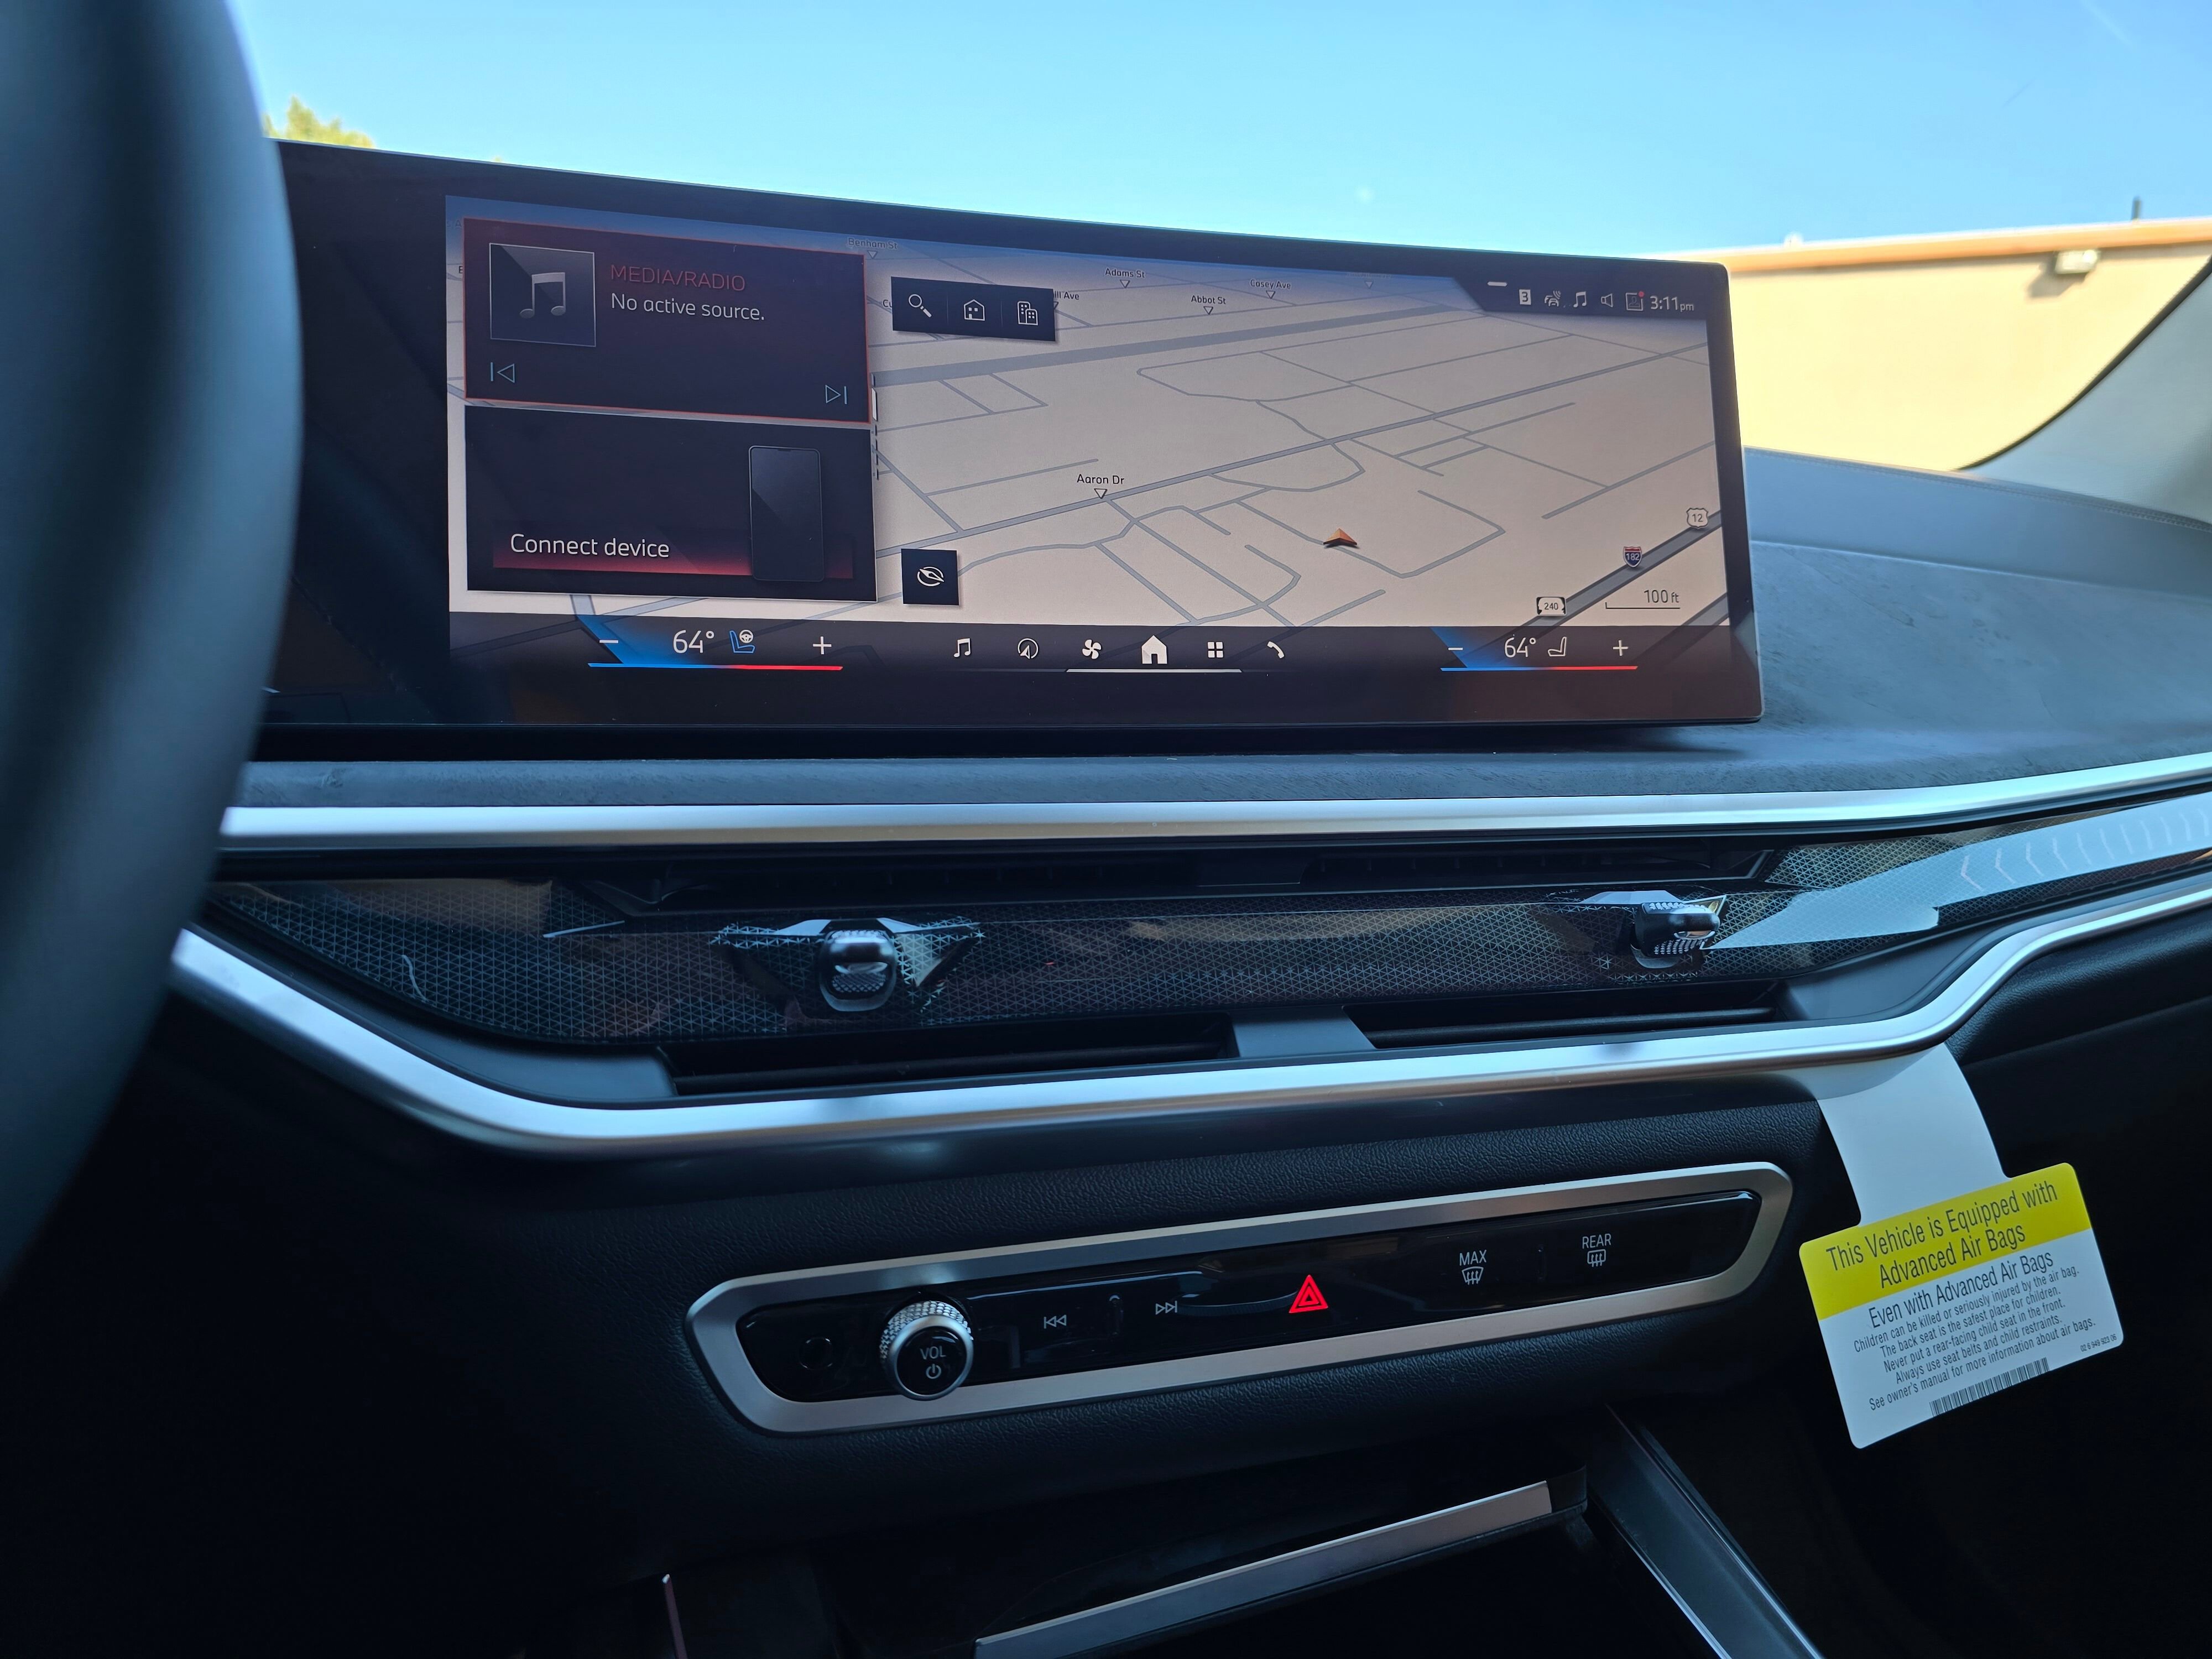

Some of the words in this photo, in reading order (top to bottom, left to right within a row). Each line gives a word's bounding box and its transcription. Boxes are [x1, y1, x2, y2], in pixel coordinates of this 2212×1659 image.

[848, 238, 885, 248] Benham
[611, 264, 745, 291] MEDIA/RADIO
[1105, 268, 1134, 278] Adams
[1136, 270, 1145, 278] St
[1250, 279, 1274, 289] Casey
[1276, 281, 1291, 289] Ave
[1063, 291, 1079, 300] Ave
[1191, 295, 1215, 304] Abbot
[1217, 296, 1226, 305] St
[612, 293, 637, 311] No
[643, 295, 696, 316] active
[701, 302, 765, 321] source.
[1077, 473, 1109, 484] Aaron
[1112, 475, 1125, 484] Dr
[1692, 513, 1703, 523] 12
[510, 533, 598, 556] Connect
[604, 538, 670, 558] device
[1625, 553, 1640, 562] 182
[1644, 589, 1669, 603] 100
[1671, 592, 1679, 603] ft
[1544, 602, 1559, 611] 240
[673, 629, 714, 654] 64°
[1505, 637, 1536, 658] 64°
[1825, 1241, 1864, 1271] This
[1864, 1222, 1926, 1258] Vehicle
[1927, 1216, 1944, 1239] is
[1945, 1190, 2020, 1233] Equipped
[2021, 1180, 2058, 1208] with
[1582, 1233, 1611, 1249] REAR
[1459, 1249, 1487, 1266] MAX
[1880, 1241, 1957, 1289] Advanced
[1960, 1235, 1982, 1261] Air
[1984, 1225, 2026, 1252] Bags
[1868, 1303, 1903, 1329] Even
[1903, 1289, 1934, 1316] with
[1936, 1265, 1999, 1306] Advanced
[2000, 1260, 2018, 1283] Air
[2019, 1252, 2054, 1275] Bags
[1854, 1332, 1889, 1353] Children
[1890, 1326, 1906, 1339] can
[1906, 1321, 1918, 1333] be
[1918, 1310, 1942, 1328] killed
[1943, 1308, 1952, 1319] or
[1954, 1295, 1990, 1316] seriously
[1992, 1282, 2021, 1302] injured
[2021, 1281, 2032, 1292] by
[2033, 1276, 2047, 1287] the
[2048, 1271, 2059, 1282] air
[2060, 1266, 2080, 1278] bag.
[1879, 1344, 1897, 1358] The
[1897, 1334, 1918, 1352] back
[1919, 1327, 1938, 1344] seat
[1937, 1325, 1947, 1337] is
[1947, 1321, 1961, 1333] the
[1963, 1309, 1988, 1328] safest
[1989, 1303, 2010, 1321] place
[2011, 1298, 2023, 1310] for
[2026, 1286, 2061, 1305] children.
[1883, 1355, 1908, 1373] Never
[1910, 1348, 1925, 1365] put
[1925, 1347, 1932, 1357] a
[1932, 1330, 1977, 1354] rear-facing
[1978, 1319, 1999, 1337] child
[1999, 1313, 2017, 1329] seat
[2018, 1312, 2027, 1322] in
[2027, 1307, 2041, 1319] the
[2042, 1297, 2065, 1313] front.
[920, 1345, 946, 1360] VOL
[1896, 1365, 1924, 1385] Always
[1926, 1359, 1941, 1372] use
[1942, 1349, 1960, 1366] seat
[1960, 1343, 1982, 1358] belts
[1983, 1334, 1999, 1350] and
[2000, 1327, 2020, 1344] child
[2021, 1314, 2062, 1336] restraints.
[1869, 1396, 1885, 1411] See
[1919, 1368, 1950, 1390] manual
[1951, 1365, 1963, 1378] for
[1965, 1357, 1987, 1372] more
[1988, 1339, 2034, 1364] information
[2036, 1328, 2059, 1345] about
[2060, 1324, 2071, 1337] air
[2072, 1318, 2096, 1332] bags.
